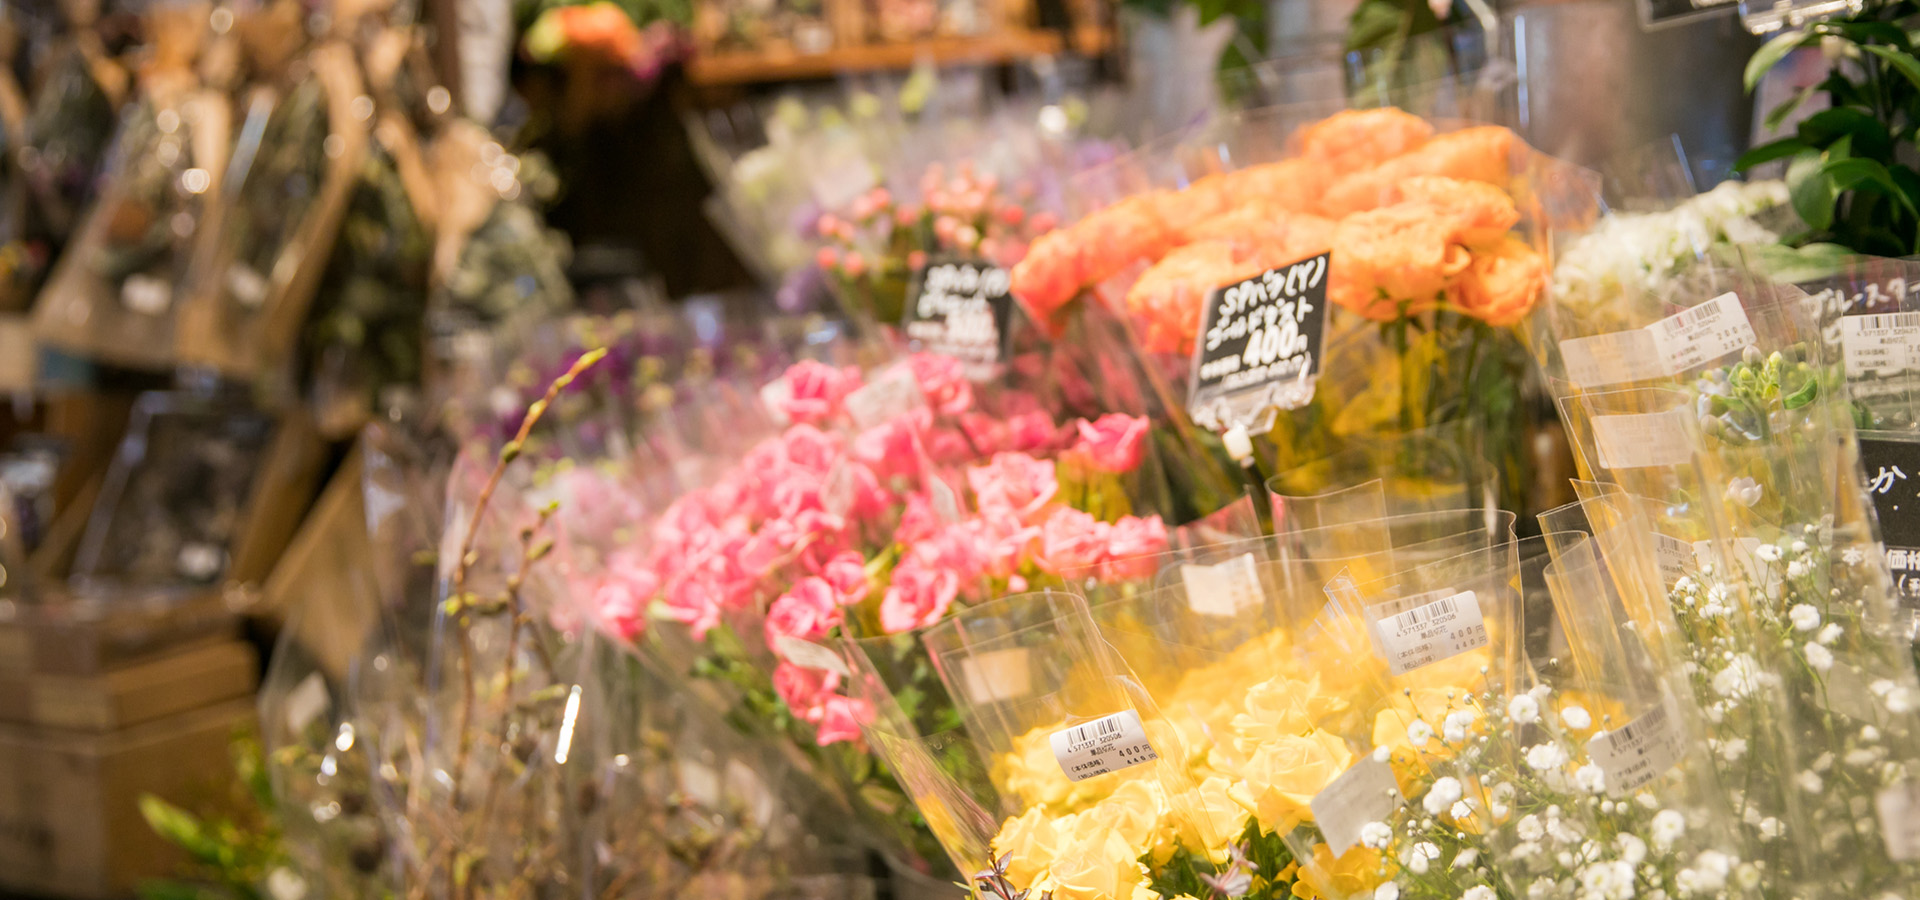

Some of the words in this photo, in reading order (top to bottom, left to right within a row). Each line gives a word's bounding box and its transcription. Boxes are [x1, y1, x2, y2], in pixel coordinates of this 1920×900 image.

[1868, 465, 1920, 497] か
[1404, 622, 1427, 636] 571337
[1074, 740, 1096, 752] 571337
[1100, 732, 1122, 744] 320506
